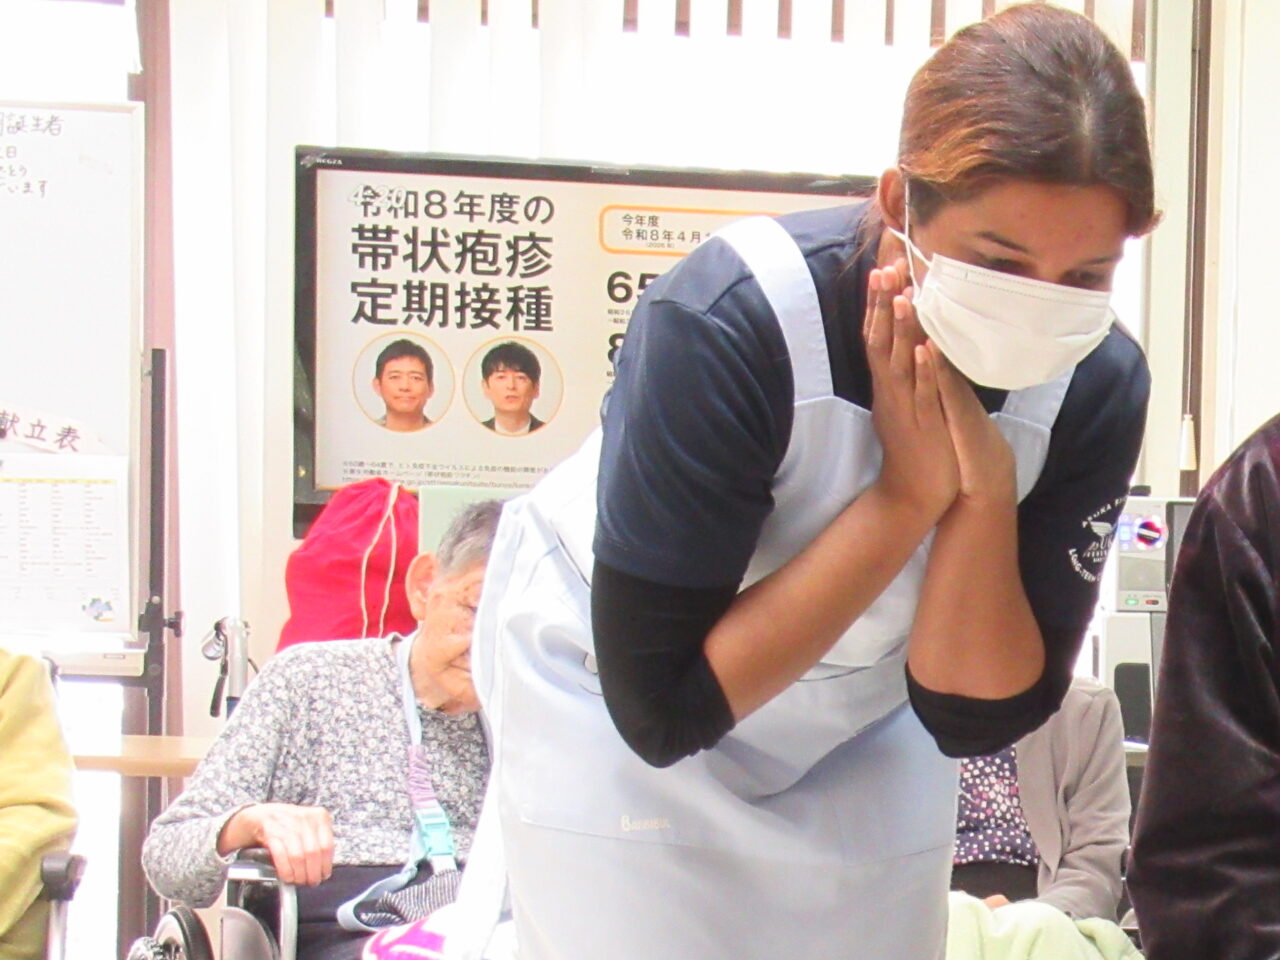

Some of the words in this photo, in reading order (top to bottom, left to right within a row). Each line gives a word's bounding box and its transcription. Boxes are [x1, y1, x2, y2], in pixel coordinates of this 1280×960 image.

[357, 185, 555, 224] 令和8年度の
[622, 214, 660, 229] 今年度
[351, 223, 554, 280] 帯状疱疹
[351, 277, 554, 332] 定期接種
